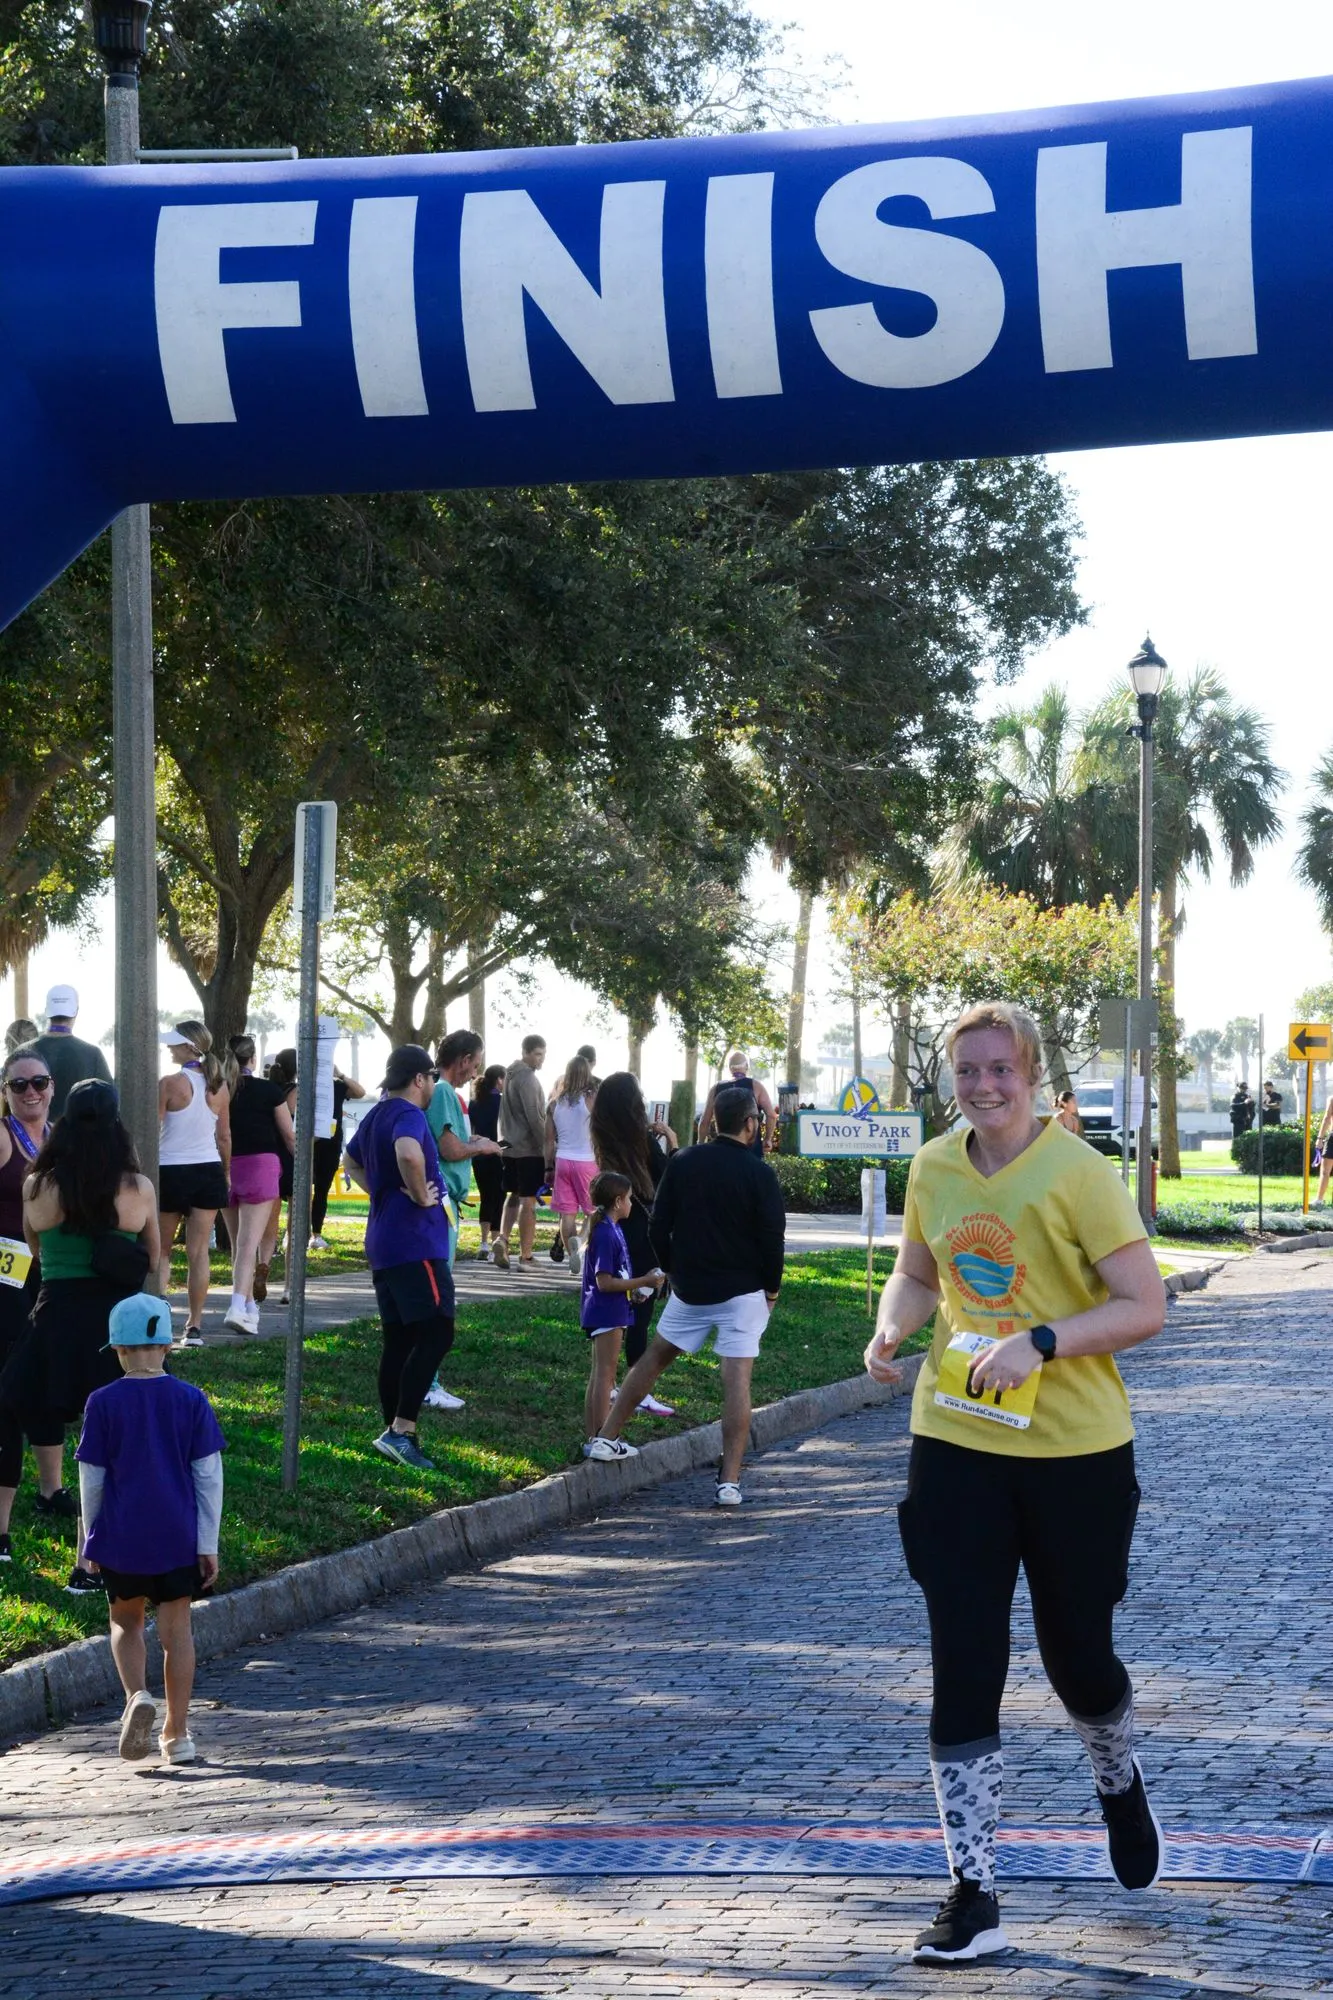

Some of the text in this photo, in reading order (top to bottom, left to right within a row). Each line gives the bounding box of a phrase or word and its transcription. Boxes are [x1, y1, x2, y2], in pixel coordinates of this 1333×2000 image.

[153, 125, 1258, 425] FINISH
[811, 1122, 911, 1138] VINOY PARK
[943, 1399, 1020, 1426] www.Run4aCause.org
